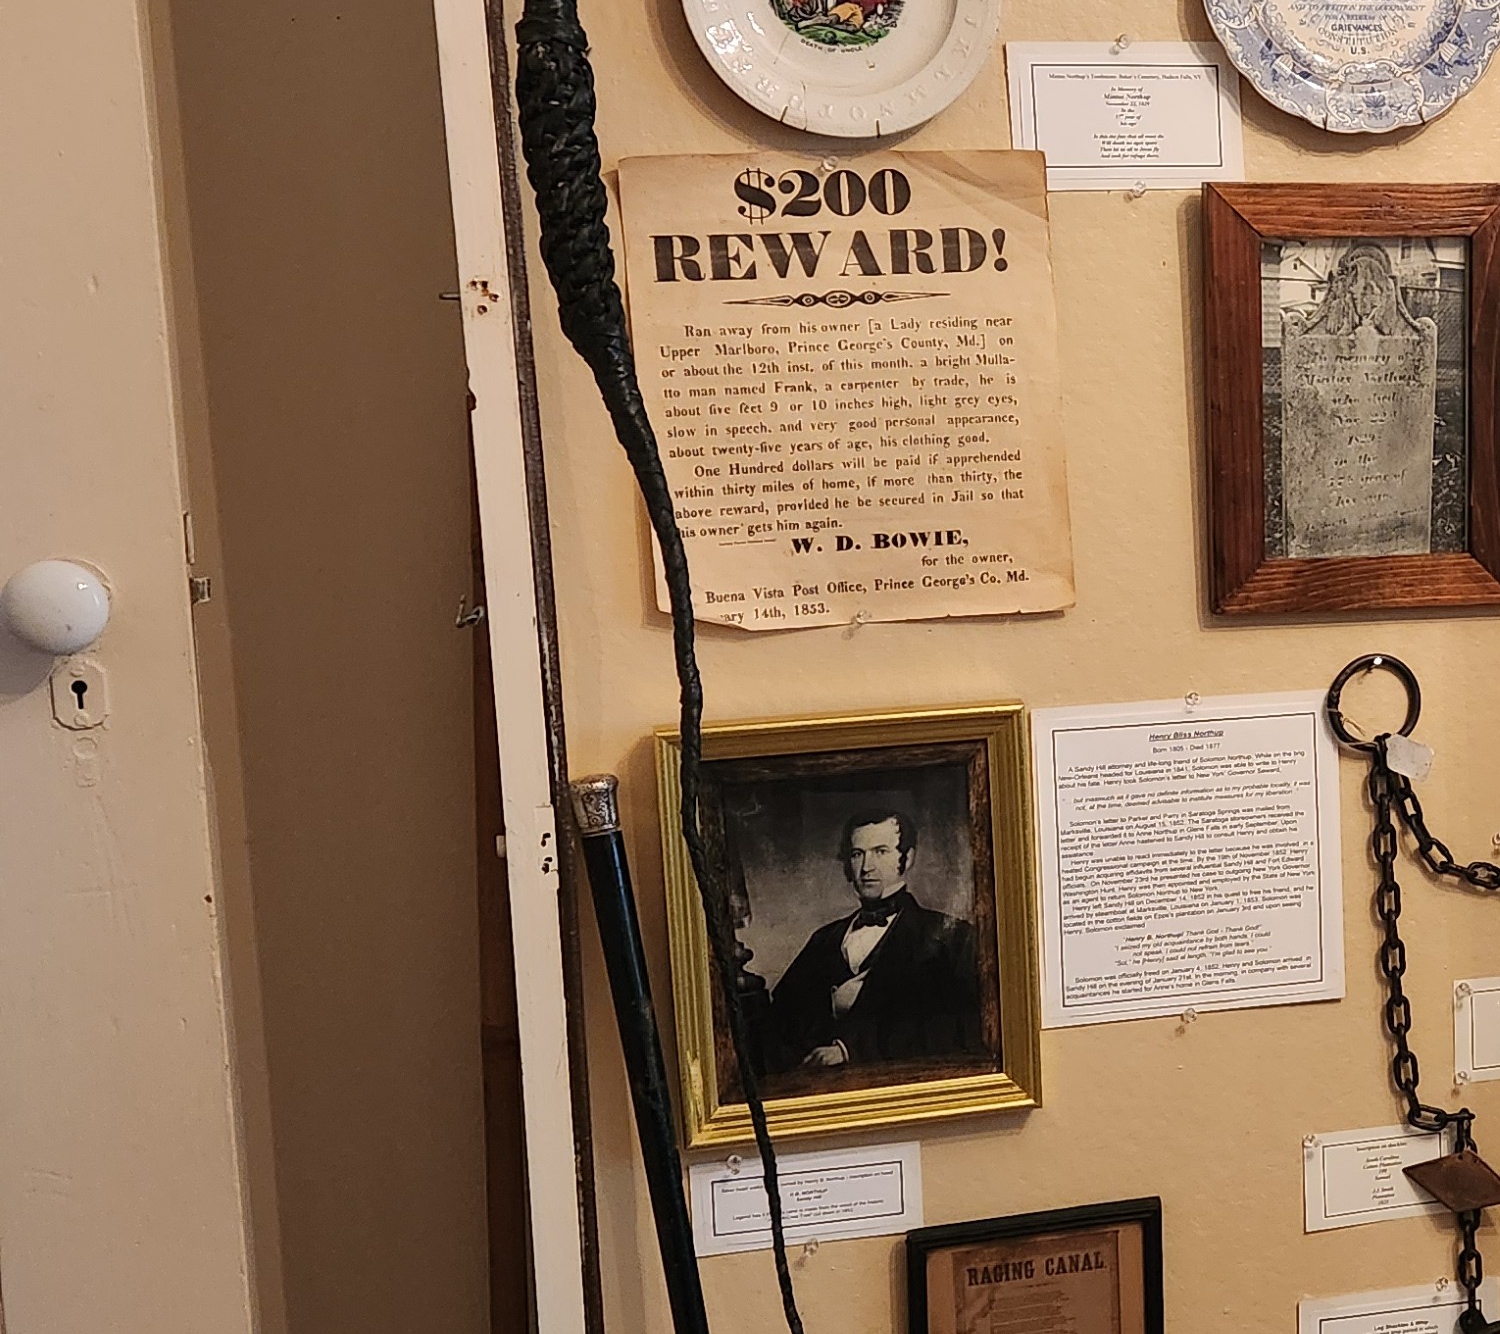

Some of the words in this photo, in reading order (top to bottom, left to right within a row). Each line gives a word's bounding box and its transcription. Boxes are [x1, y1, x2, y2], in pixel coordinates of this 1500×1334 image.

[1331, 23, 1383, 32] GRIEVANCES
[1350, 46, 1371, 55] U.S.
[733, 167, 911, 225] $200
[649, 228, 1009, 282] REWARD!
[683, 325, 712, 338] Ran
[719, 327, 753, 339] away
[761, 323, 791, 335] from
[799, 321, 818, 334] his
[820, 323, 861, 333] owner
[890, 317, 922, 333] Lady
[929, 315, 978, 331] residing
[985, 317, 1013, 328] near
[659, 345, 701, 362] Upper
[714, 342, 780, 356] Marlboro,
[788, 340, 830, 354] Prince
[837, 337, 893, 354] George's
[900, 337, 949, 351] County,
[956, 333, 986, 350] Md.]
[998, 337, 1014, 347] on
[661, 369, 676, 379] or
[683, 364, 720, 377] about
[722, 362, 743, 376] the
[752, 361, 780, 374] 12th
[822, 359, 836, 371] of
[840, 358, 864, 371] this
[920, 359, 928, 368] a
[934, 354, 971, 370] bright
[975, 353, 1016, 366] Mulla-
[663, 388, 681, 399] tto
[688, 387, 717, 398] man
[724, 381, 766, 396] named
[774, 380, 818, 394] Frank,
[824, 383, 833, 392] a
[912, 376, 926, 391] by
[933, 374, 970, 388] trade,
[979, 373, 994, 386] he
[1006, 372, 1016, 385] is
[664, 405, 701, 418] about
[708, 403, 732, 415] five
[739, 401, 763, 414] feet
[770, 401, 778, 413] 9
[789, 403, 804, 412] or
[812, 399, 828, 411] 10
[834, 397, 874, 411] inches
[919, 394, 947, 409] light
[954, 396, 980, 409] grey
[987, 395, 1018, 408] eyes,
[666, 425, 697, 439] slow
[705, 423, 718, 437] in
[779, 419, 803, 433] and
[810, 421, 838, 433] very
[848, 416, 877, 433] good
[884, 414, 936, 431] personal
[946, 414, 1020, 429] appearance,
[668, 446, 706, 459] about
[711, 441, 782, 458] twenty-five
[789, 441, 824, 455] years
[827, 438, 841, 450] of
[846, 441, 873, 453] age,
[880, 435, 898, 447] his
[902, 433, 951, 449] clothing
[957, 431, 990, 448] good.
[694, 465, 721, 480] One
[728, 460, 784, 476] Hundred
[792, 459, 834, 472] dollars
[841, 456, 866, 469] will
[872, 456, 888, 468] be
[895, 454, 921, 471] paid
[928, 453, 939, 465] if
[946, 449, 1022, 468] apprehended
[674, 486, 714, 500] within
[721, 482, 757, 498] thirty
[762, 479, 795, 493] miles
[802, 477, 814, 491] of
[821, 478, 861, 491] home,
[866, 475, 878, 488] if
[883, 476, 915, 487] more
[927, 472, 954, 485] than
[960, 470, 998, 485] thirty,
[1003, 468, 1023, 481] the
[675, 507, 713, 520] above
[719, 500, 770, 517] reward,
[776, 497, 830, 516] provided
[834, 497, 850, 509] he
[856, 495, 872, 507] be
[878, 492, 926, 507] secured
[932, 491, 944, 504] in
[950, 489, 974, 503] Jail
[980, 492, 994, 501] so
[1001, 487, 1024, 500] that
[747, 522, 773, 537] gets
[775, 519, 800, 532] him
[805, 517, 842, 532] again.
[791, 538, 823, 555] W.
[834, 535, 862, 552] D.
[871, 530, 969, 550] BOWIE,
[920, 555, 939, 567] for
[944, 553, 965, 566] the
[971, 553, 1014, 564] owner,
[704, 591, 746, 604] Buena
[752, 587, 785, 600] Vista
[792, 583, 820, 597] Post
[826, 580, 868, 595] Office,
[874, 578, 915, 591] Prince
[921, 573, 976, 591] George's
[979, 571, 1002, 585] Co.
[1006, 569, 1030, 583] Md.
[754, 605, 786, 620] 14th,
[794, 602, 830, 617] 1853.
[966, 1259, 1035, 1286] RAGING
